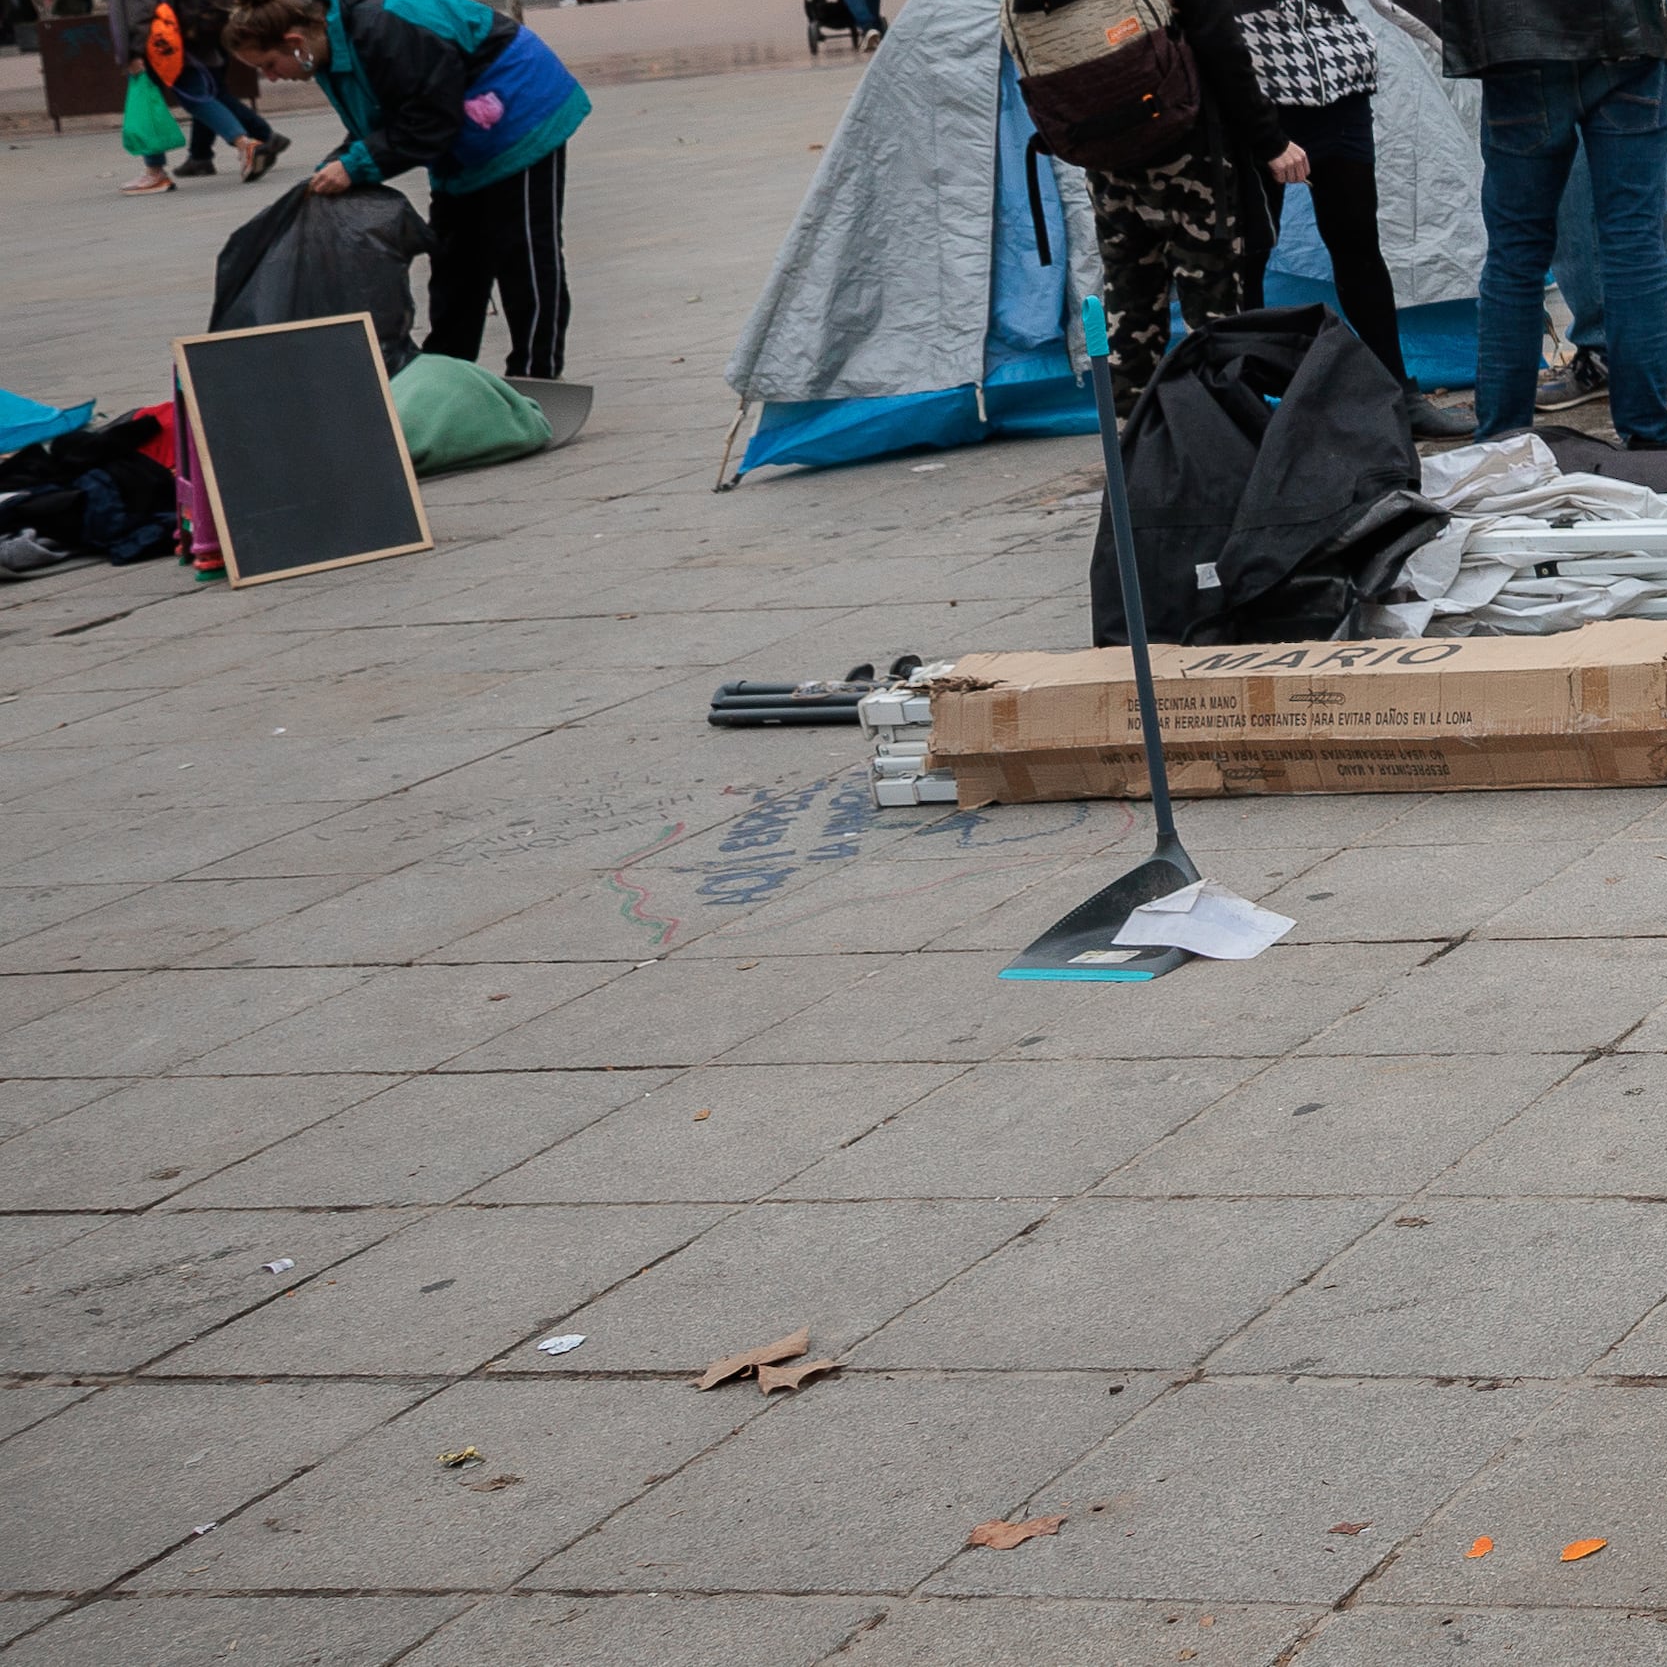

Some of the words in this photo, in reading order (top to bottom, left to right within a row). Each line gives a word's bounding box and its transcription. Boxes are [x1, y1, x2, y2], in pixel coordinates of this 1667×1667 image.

[1184, 643, 1463, 672] MARIO
[1201, 698, 1207, 710] A
[1210, 696, 1237, 710] MANO
[1128, 717, 1142, 730] NO
[1174, 714, 1247, 730] HERRAMIENTAS
[1250, 713, 1307, 728] CORTANTES
[1338, 712, 1371, 726] EVITAR
[1375, 708, 1409, 726] DAÑOS
[1413, 712, 1426, 725] EN
[1430, 712, 1442, 725] LA
[1446, 711, 1473, 725] LONA
[1379, 764, 1451, 776] DESPRECINTAR
